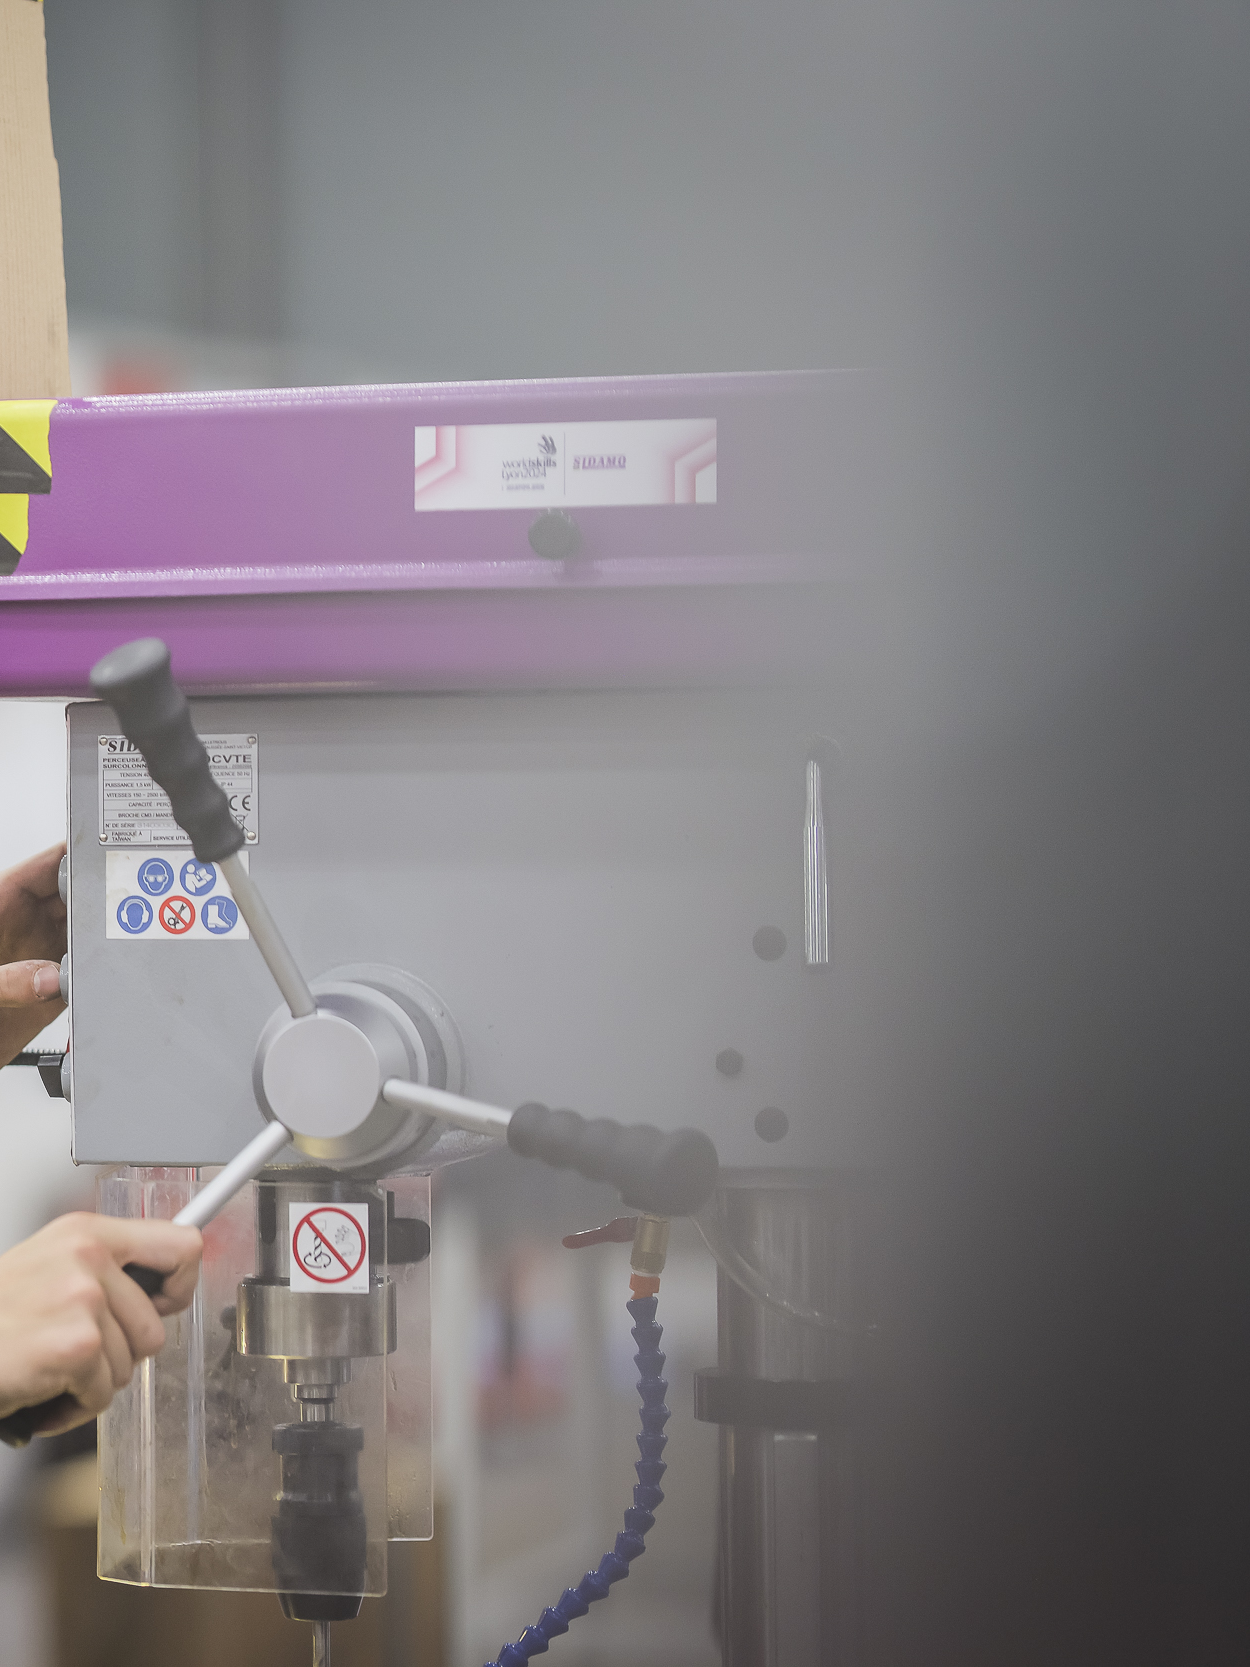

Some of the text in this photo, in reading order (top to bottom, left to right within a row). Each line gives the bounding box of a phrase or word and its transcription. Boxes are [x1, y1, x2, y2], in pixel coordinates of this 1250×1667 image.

[573, 455, 626, 470] SIDAMO
[208, 754, 252, 764] CVTE
[229, 794, 251, 812] CE
